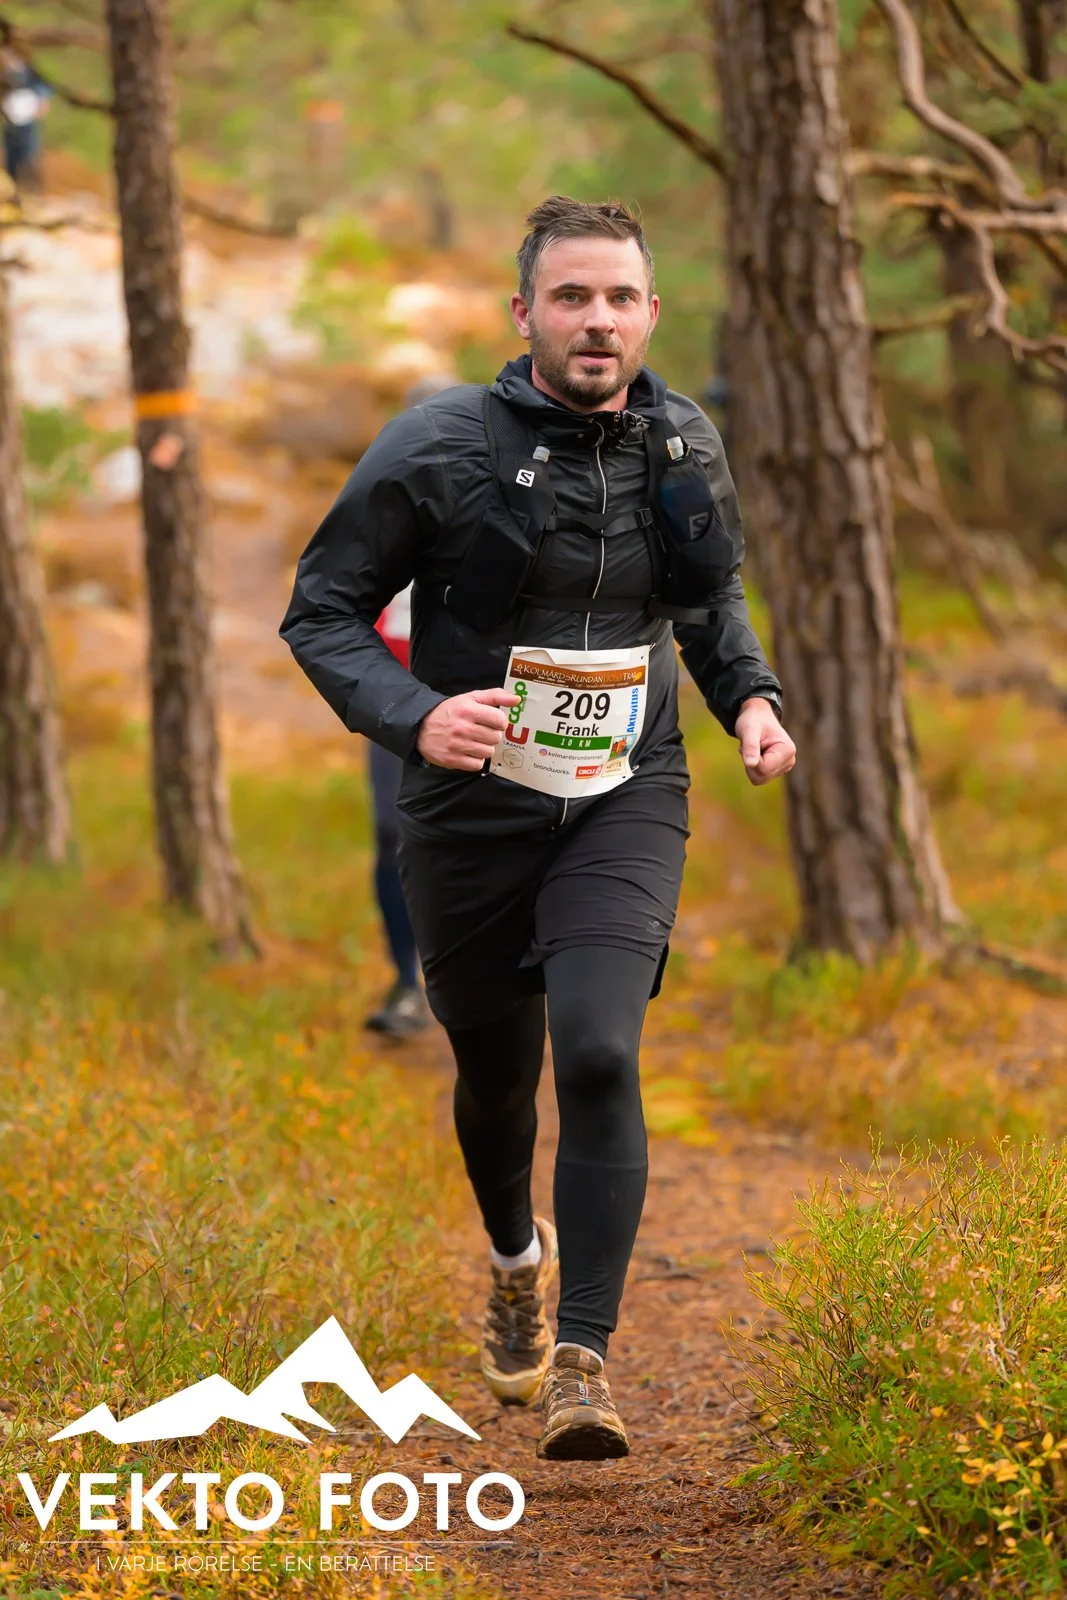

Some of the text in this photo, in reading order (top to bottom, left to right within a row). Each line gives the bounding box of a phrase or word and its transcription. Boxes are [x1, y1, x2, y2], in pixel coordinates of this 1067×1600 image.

[551, 691, 610, 721] 209
[556, 721, 600, 736] Frank
[579, 740, 592, 748] KM
